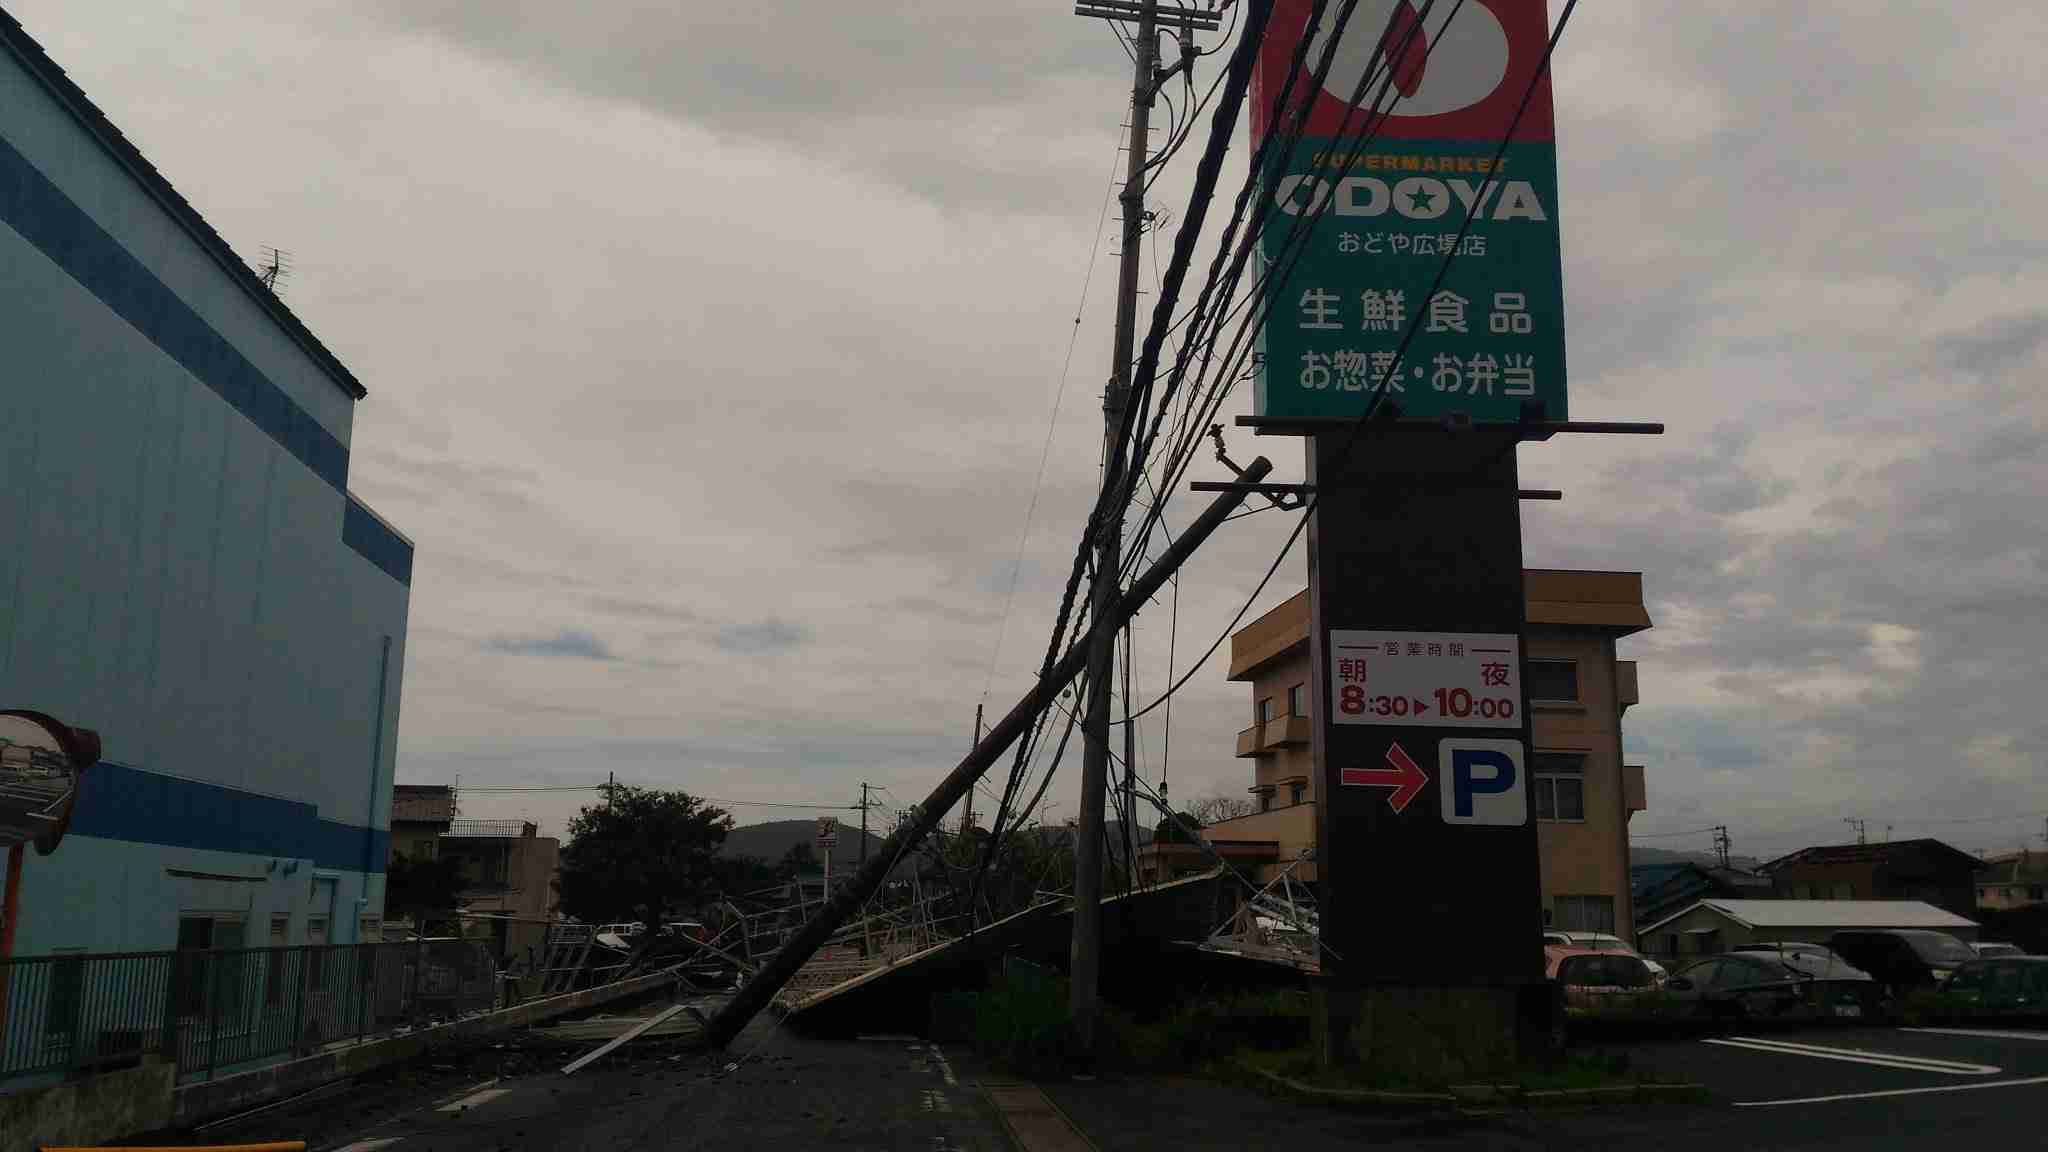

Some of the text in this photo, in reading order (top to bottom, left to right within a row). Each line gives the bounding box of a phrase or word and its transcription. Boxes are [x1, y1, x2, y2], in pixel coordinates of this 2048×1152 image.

[1338, 232, 1486, 256] おどや広場店
[1299, 289, 1532, 333] 生鮮食品
[1384, 640, 1464, 656] 営業時間
[1338, 658, 1511, 686] 朝 夜
[1341, 685, 1513, 718] 8:30 10:00
[1453, 750, 1516, 817] P
